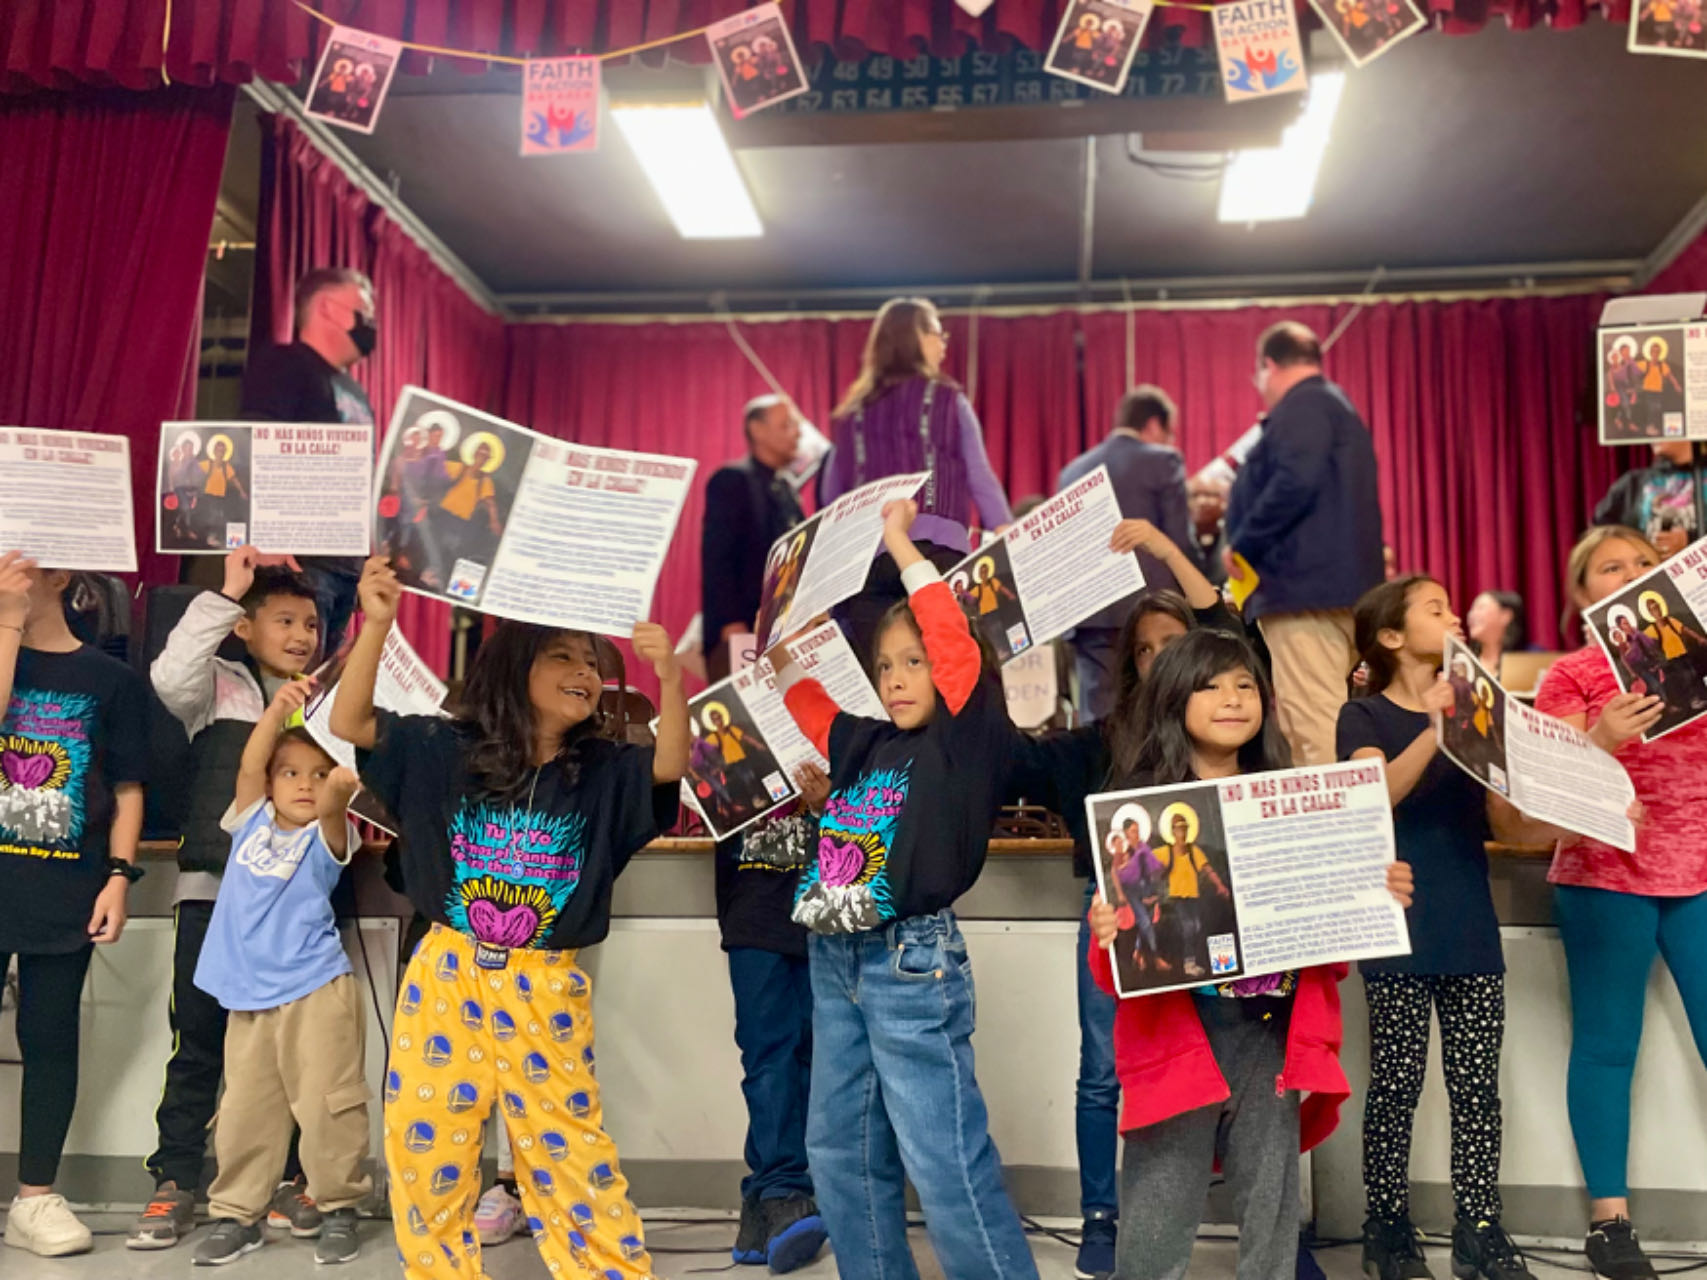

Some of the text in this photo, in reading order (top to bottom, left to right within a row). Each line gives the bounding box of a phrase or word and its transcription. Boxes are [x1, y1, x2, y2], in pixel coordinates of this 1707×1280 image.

[1218, 0, 1287, 25] FAITH
[529, 61, 593, 79] FAITH
[1323, 765, 1382, 790] VIVIENDO
[1260, 791, 1347, 818] EN LA CALLE!
[485, 823, 506, 839] Tu
[528, 830, 552, 845] Yo
[29, 846, 52, 860] Bay
[52, 849, 80, 860] Area
